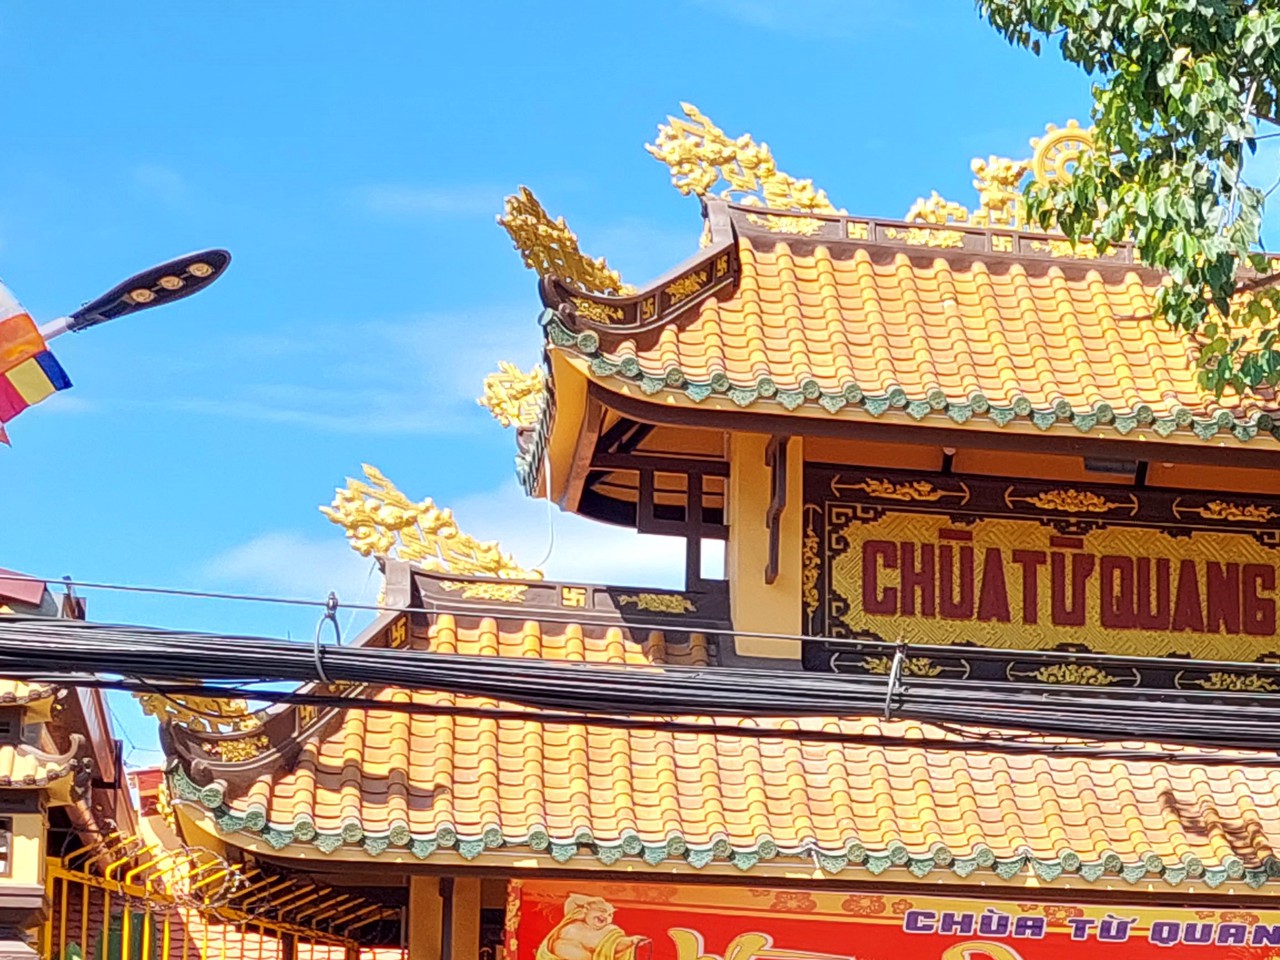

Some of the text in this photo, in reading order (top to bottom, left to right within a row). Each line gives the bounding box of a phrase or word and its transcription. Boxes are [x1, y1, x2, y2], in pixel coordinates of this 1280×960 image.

[862, 528, 1276, 636] CHÙA TỪ QUANG
[904, 909, 1044, 937] CHÙA
[1069, 913, 1137, 940] TỪ
